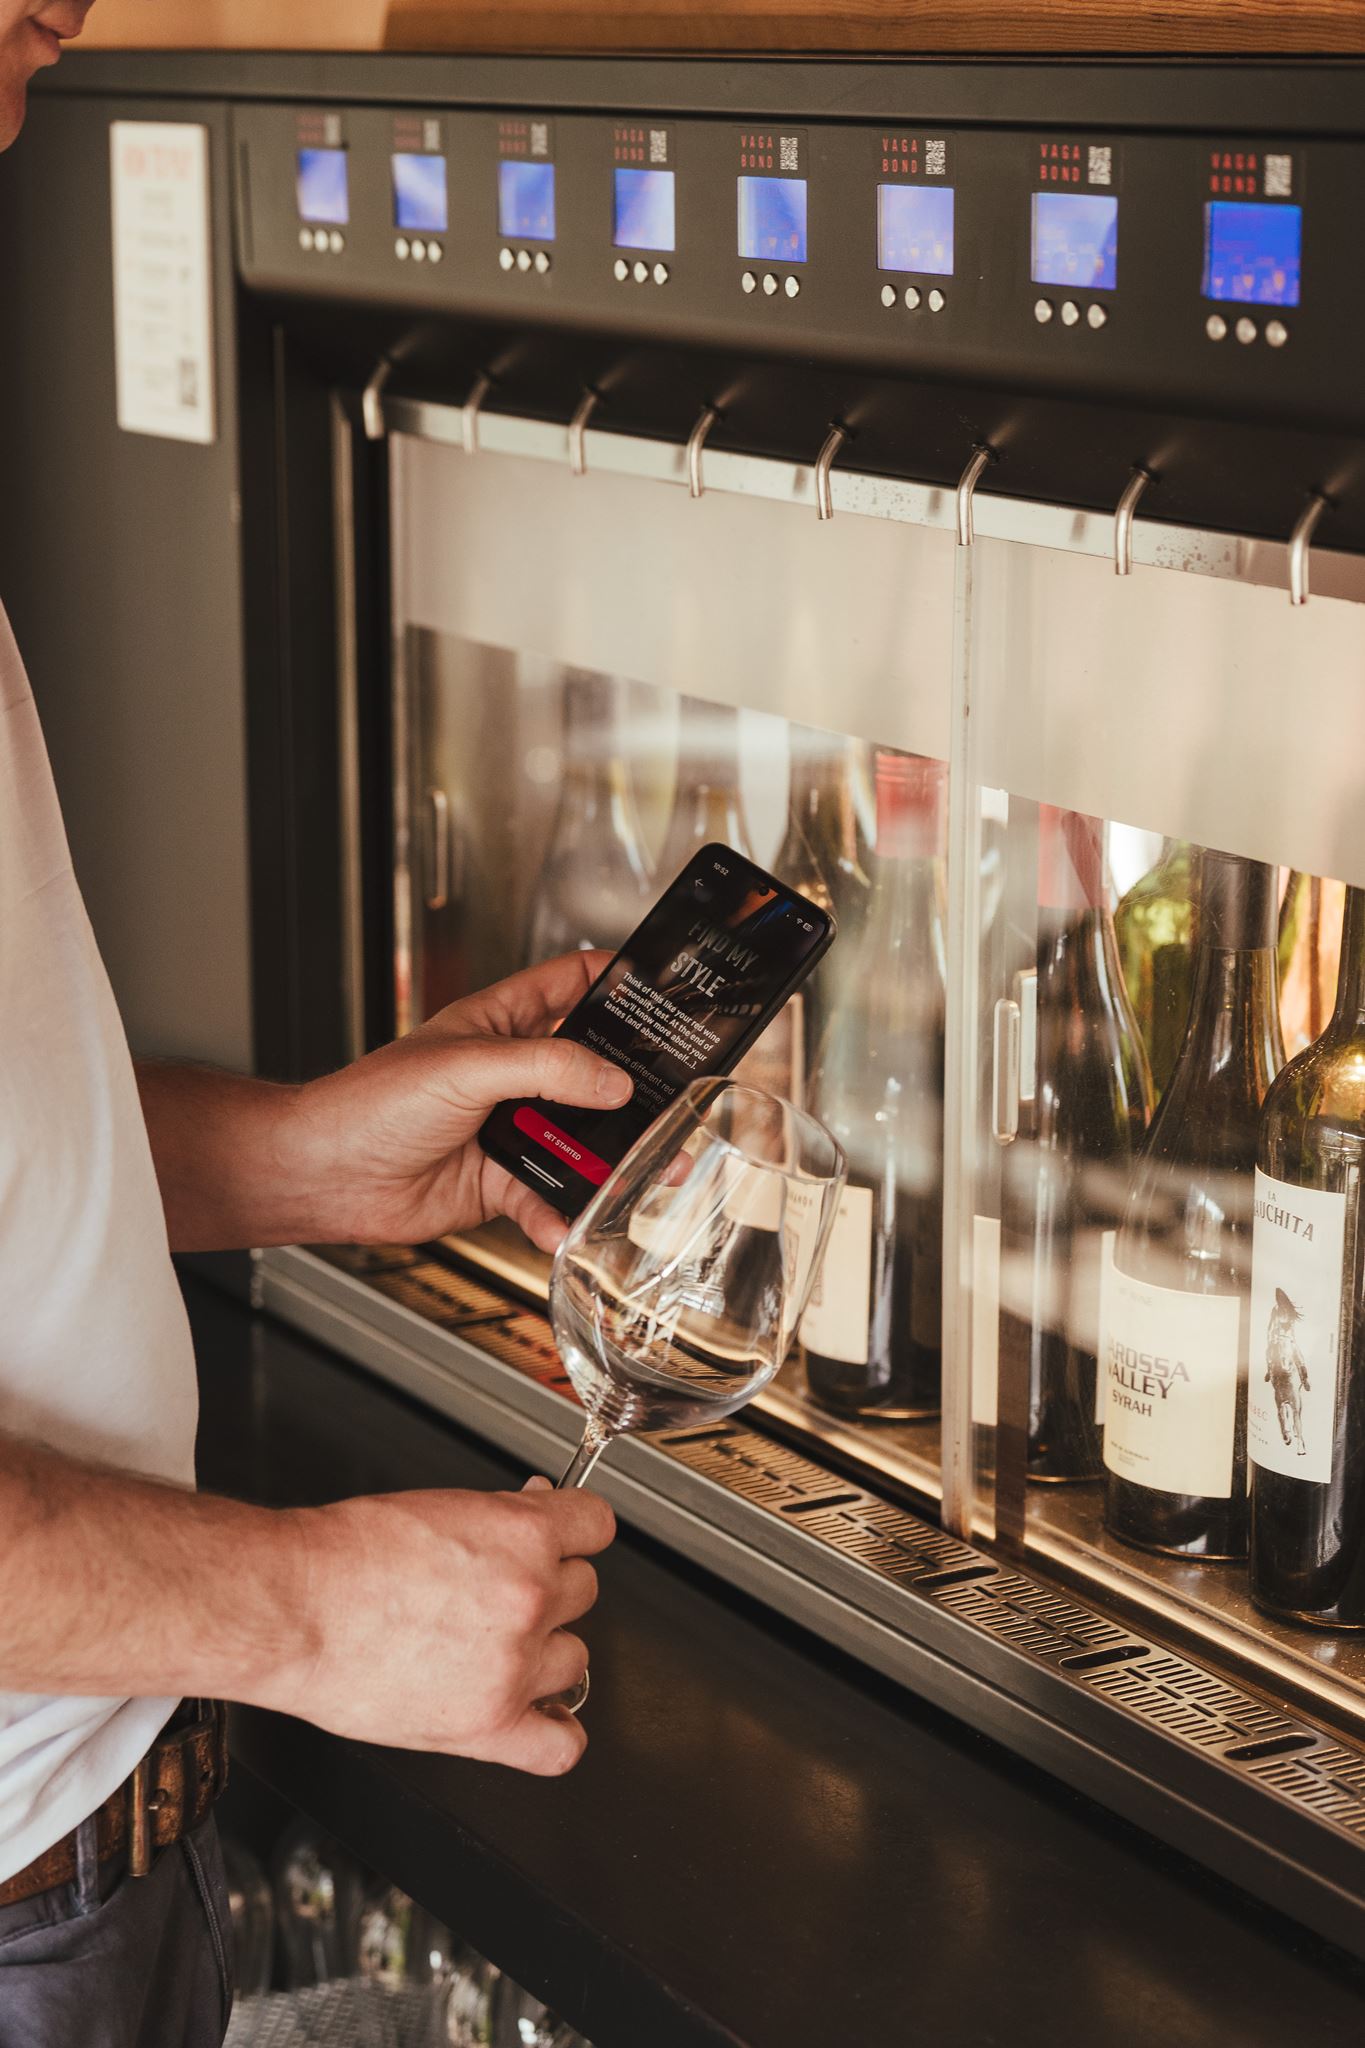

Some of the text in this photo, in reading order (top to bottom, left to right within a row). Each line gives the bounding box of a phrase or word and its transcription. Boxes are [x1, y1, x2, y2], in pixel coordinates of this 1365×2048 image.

[882, 138, 917, 153] VAGA
[1040, 144, 1080, 160] VAGA
[882, 159, 917, 173] BOND
[1040, 164, 1080, 182] BOND
[712, 862, 729, 875] 10:52
[724, 944, 758, 971] MY
[670, 951, 725, 997] STYLE
[604, 1000, 626, 1018] tastes
[640, 1026, 661, 1043] about
[615, 982, 655, 1011] personality
[653, 1007, 669, 1022] test.
[677, 1024, 691, 1036] the
[689, 1033, 705, 1046] end
[622, 970, 642, 989] Think
[649, 990, 664, 1003] this
[662, 999, 676, 1012] like
[673, 1009, 692, 1023] your
[690, 1020, 705, 1031] red
[702, 1028, 720, 1043] wine
[615, 995, 637, 1011] you'll
[634, 1007, 654, 1024] know
[652, 1021, 671, 1036] more
[670, 1034, 691, 1051] about
[688, 1047, 707, 1061] your
[586, 1027, 606, 1045] You'll
[604, 1042, 630, 1064] explore
[629, 1061, 662, 1086] different
[660, 1083, 676, 1095] red
[543, 1130, 581, 1160] GET STARTED
[1107, 1338, 1191, 1383] AROSSA
[1112, 1389, 1153, 1417] SYRAH
